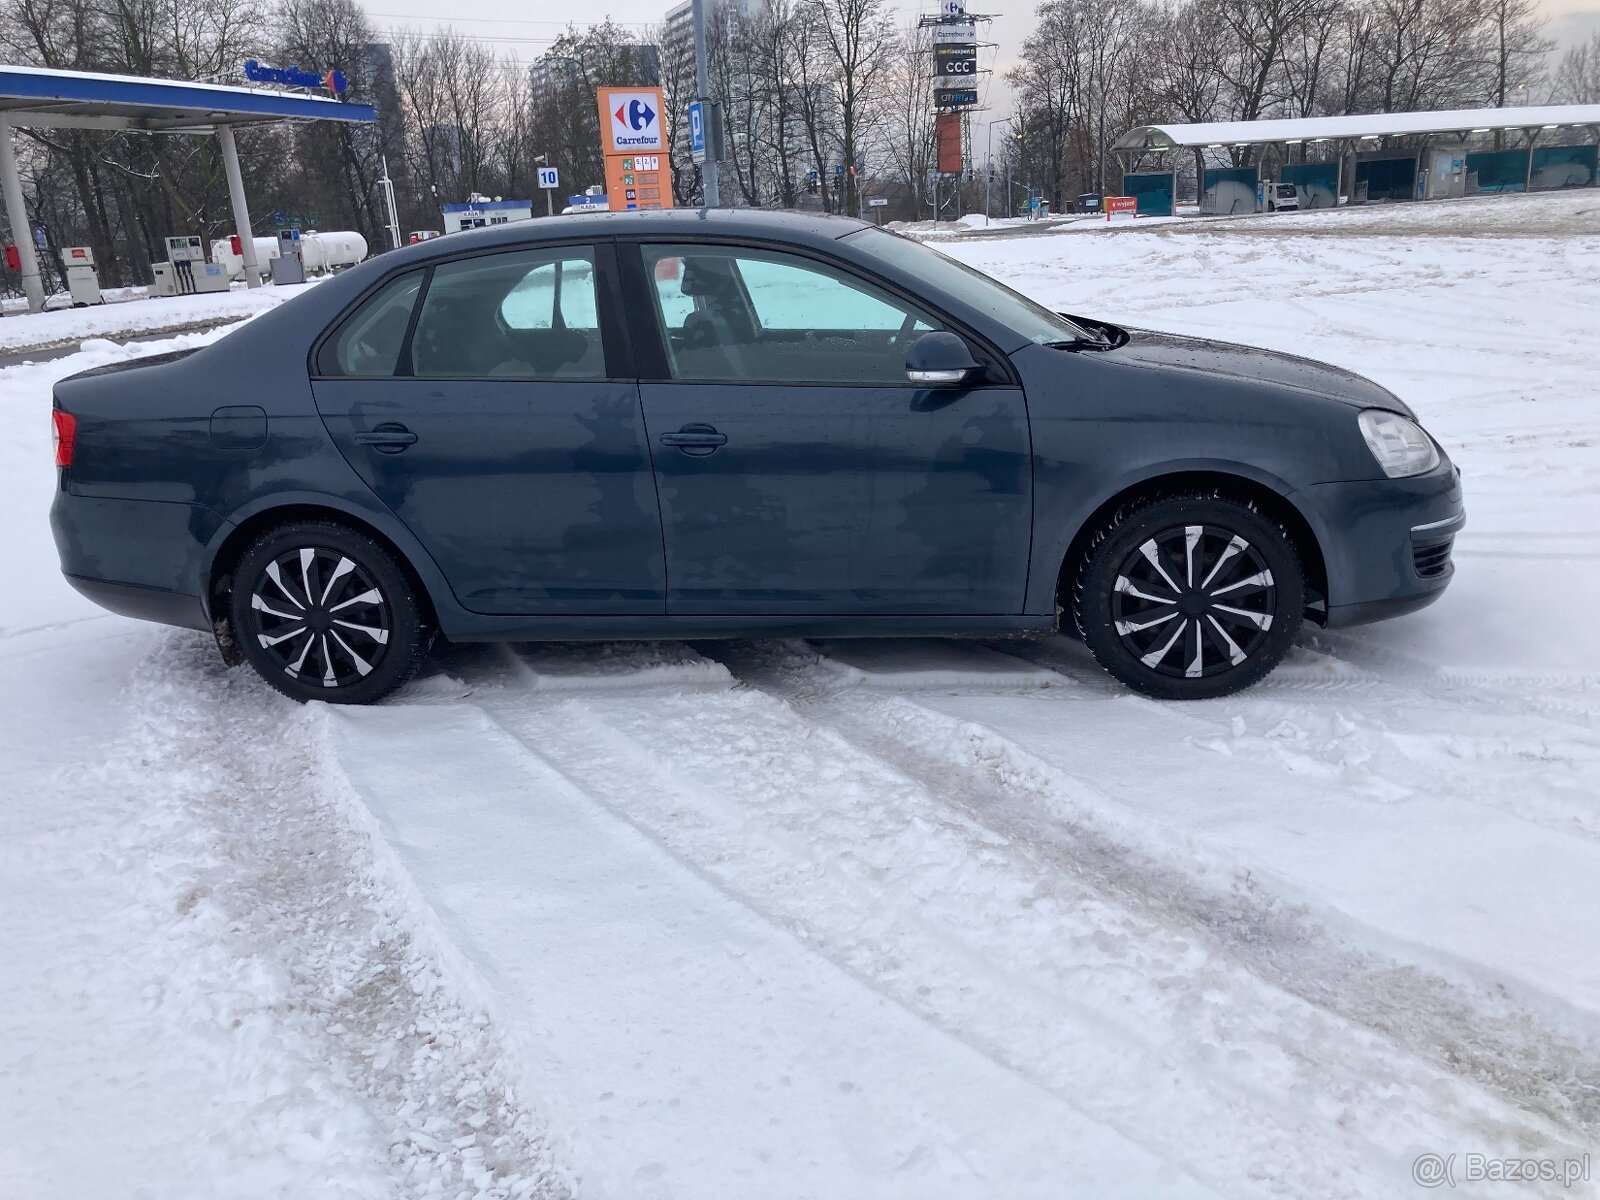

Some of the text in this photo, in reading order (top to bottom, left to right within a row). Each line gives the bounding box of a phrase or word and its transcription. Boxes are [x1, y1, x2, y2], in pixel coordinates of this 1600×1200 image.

[946, 61, 970, 72] CCC
[692, 110, 701, 146] P
[616, 135, 658, 146] Carrefour
[541, 171, 556, 184] 10
